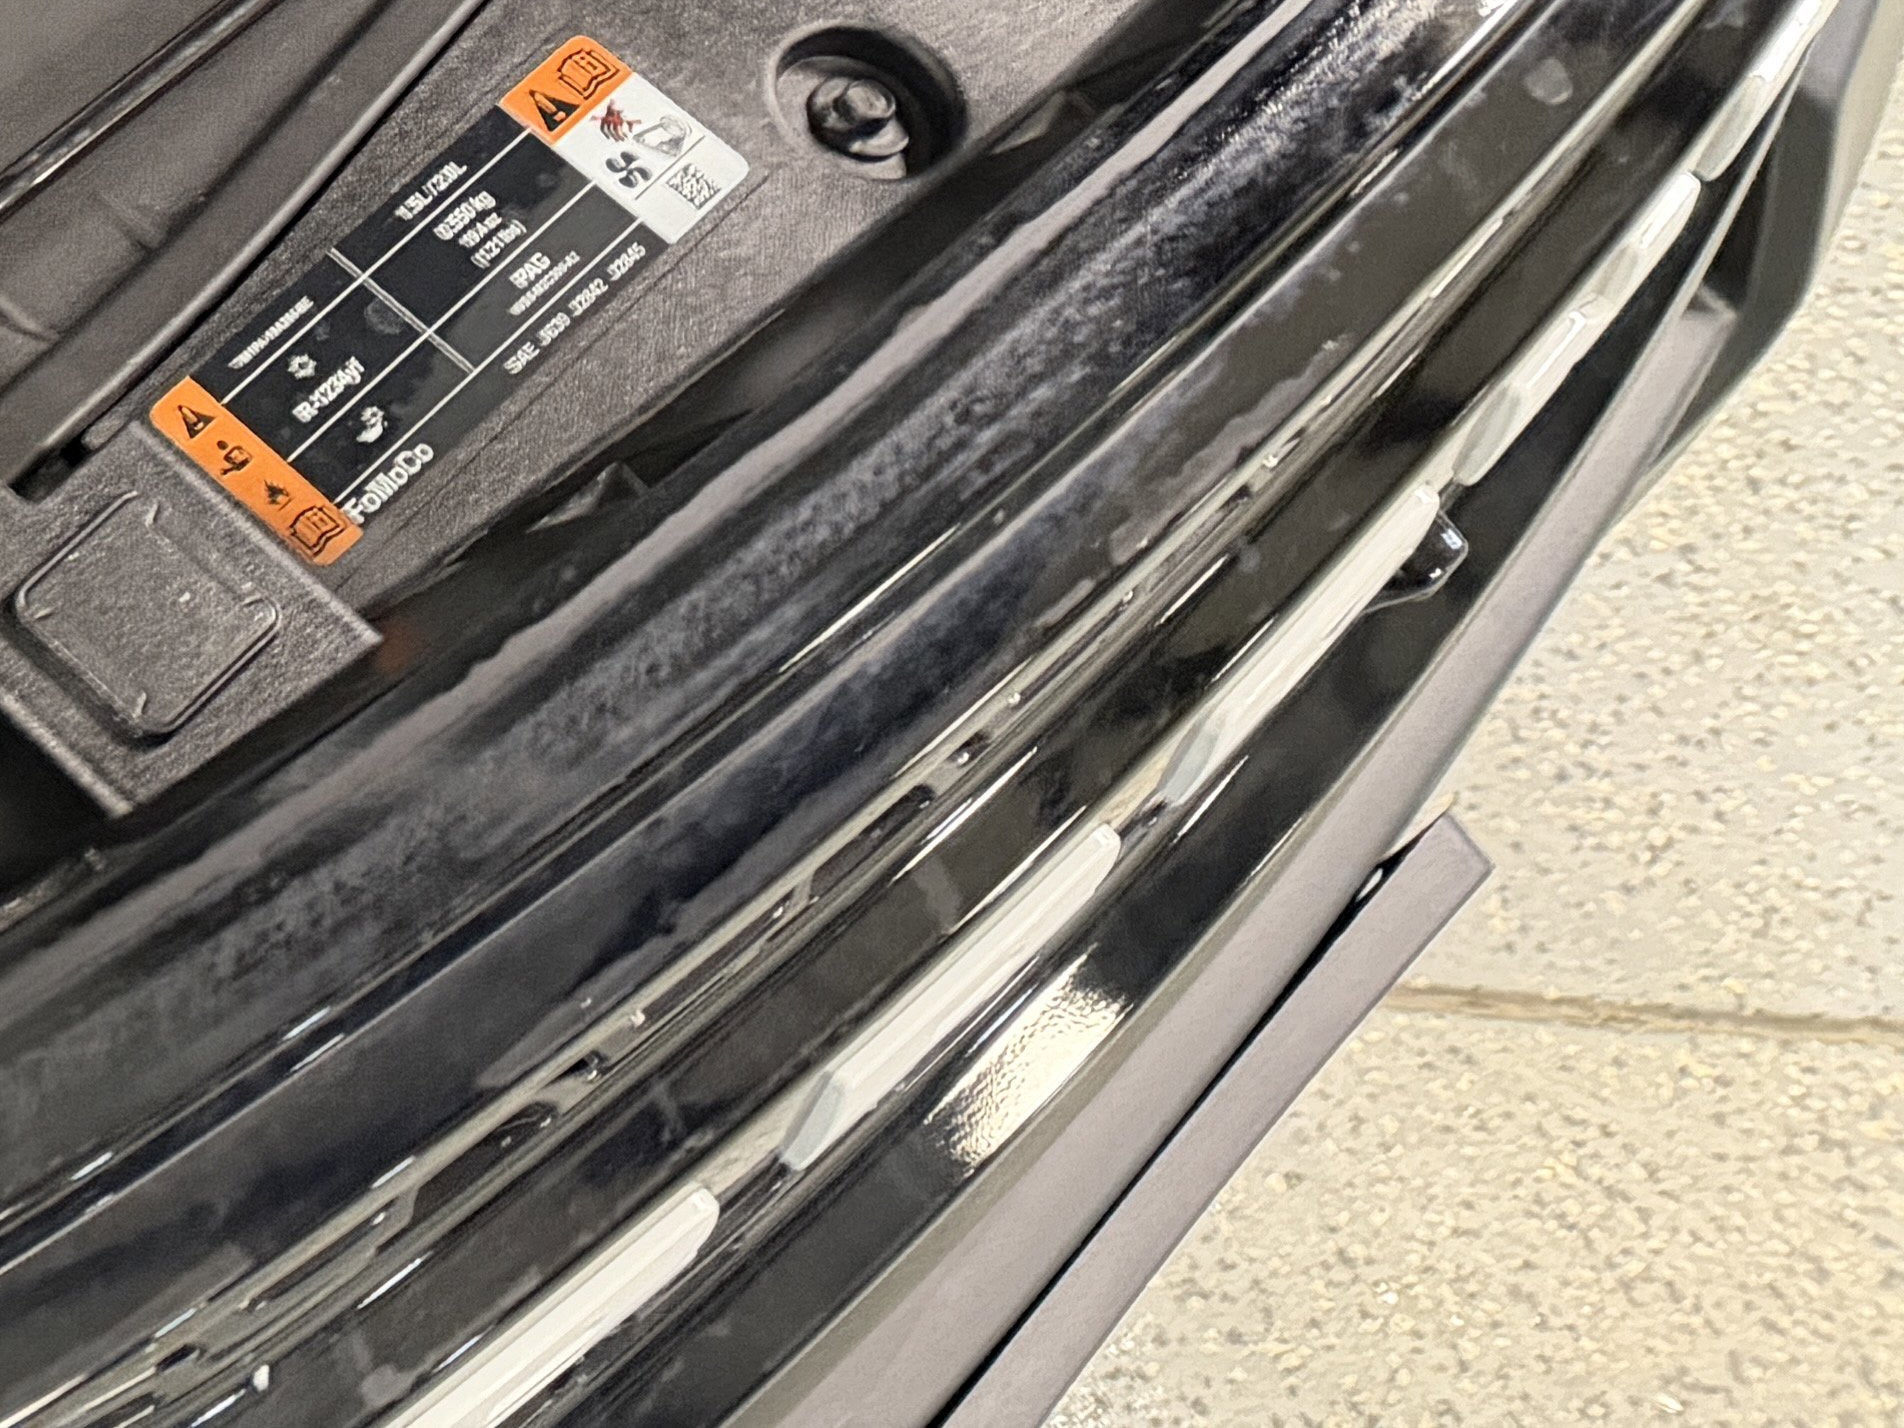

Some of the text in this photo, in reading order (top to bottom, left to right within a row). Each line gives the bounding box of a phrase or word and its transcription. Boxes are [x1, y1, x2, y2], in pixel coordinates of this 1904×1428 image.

[509, 252, 552, 290] PAG
[503, 342, 541, 375] SAE
[292, 356, 367, 423] R-1234yf
[339, 443, 435, 526] FoMoCo
